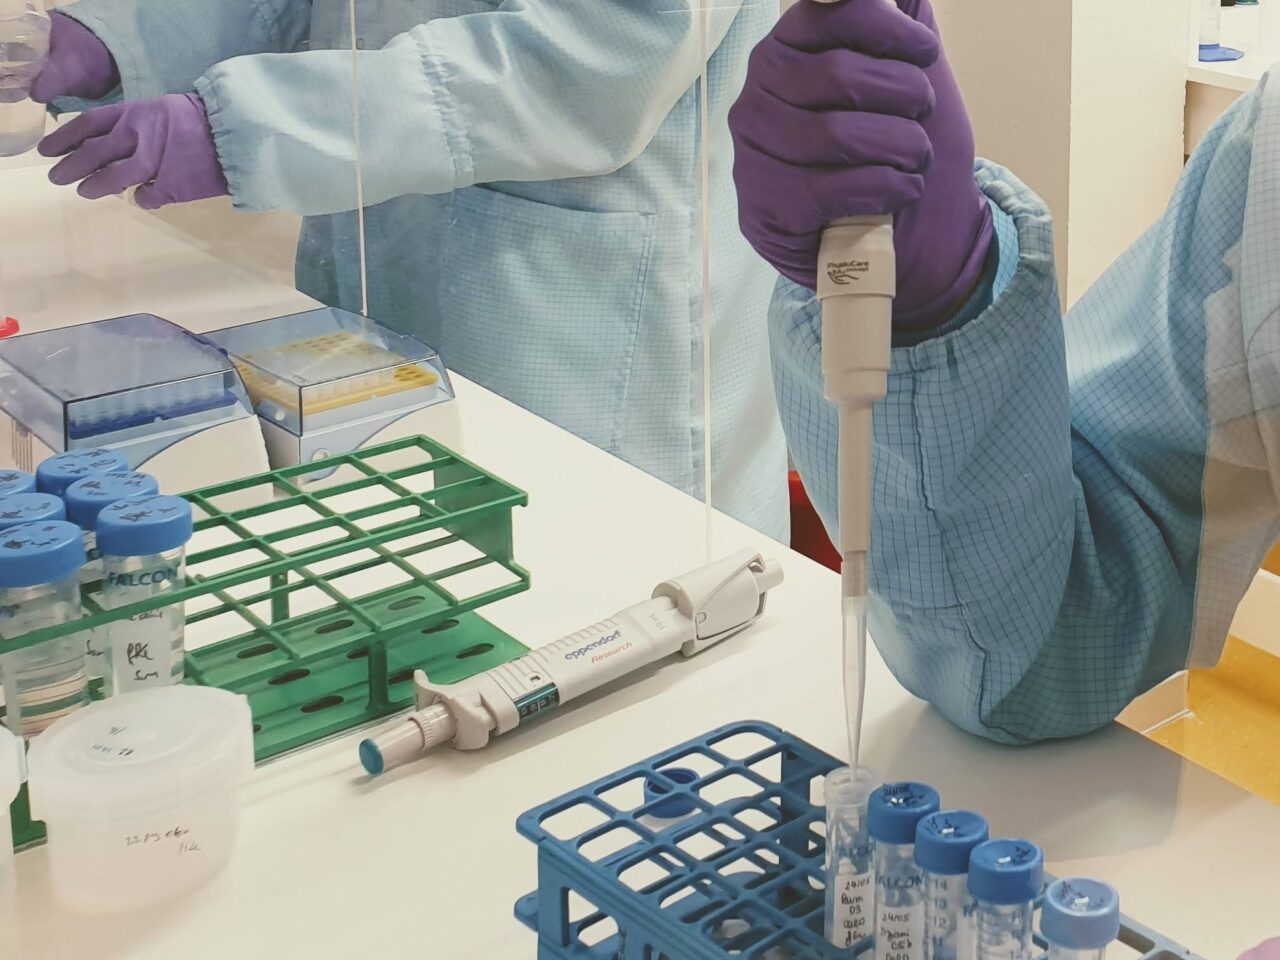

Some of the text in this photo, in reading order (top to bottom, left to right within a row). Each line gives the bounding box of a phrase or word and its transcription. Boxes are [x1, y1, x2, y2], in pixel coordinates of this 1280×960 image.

[107, 564, 179, 587] FALCON
[564, 629, 622, 662] eppendorf
[590, 641, 634, 665] Research
[877, 874, 924, 889] ALCON
